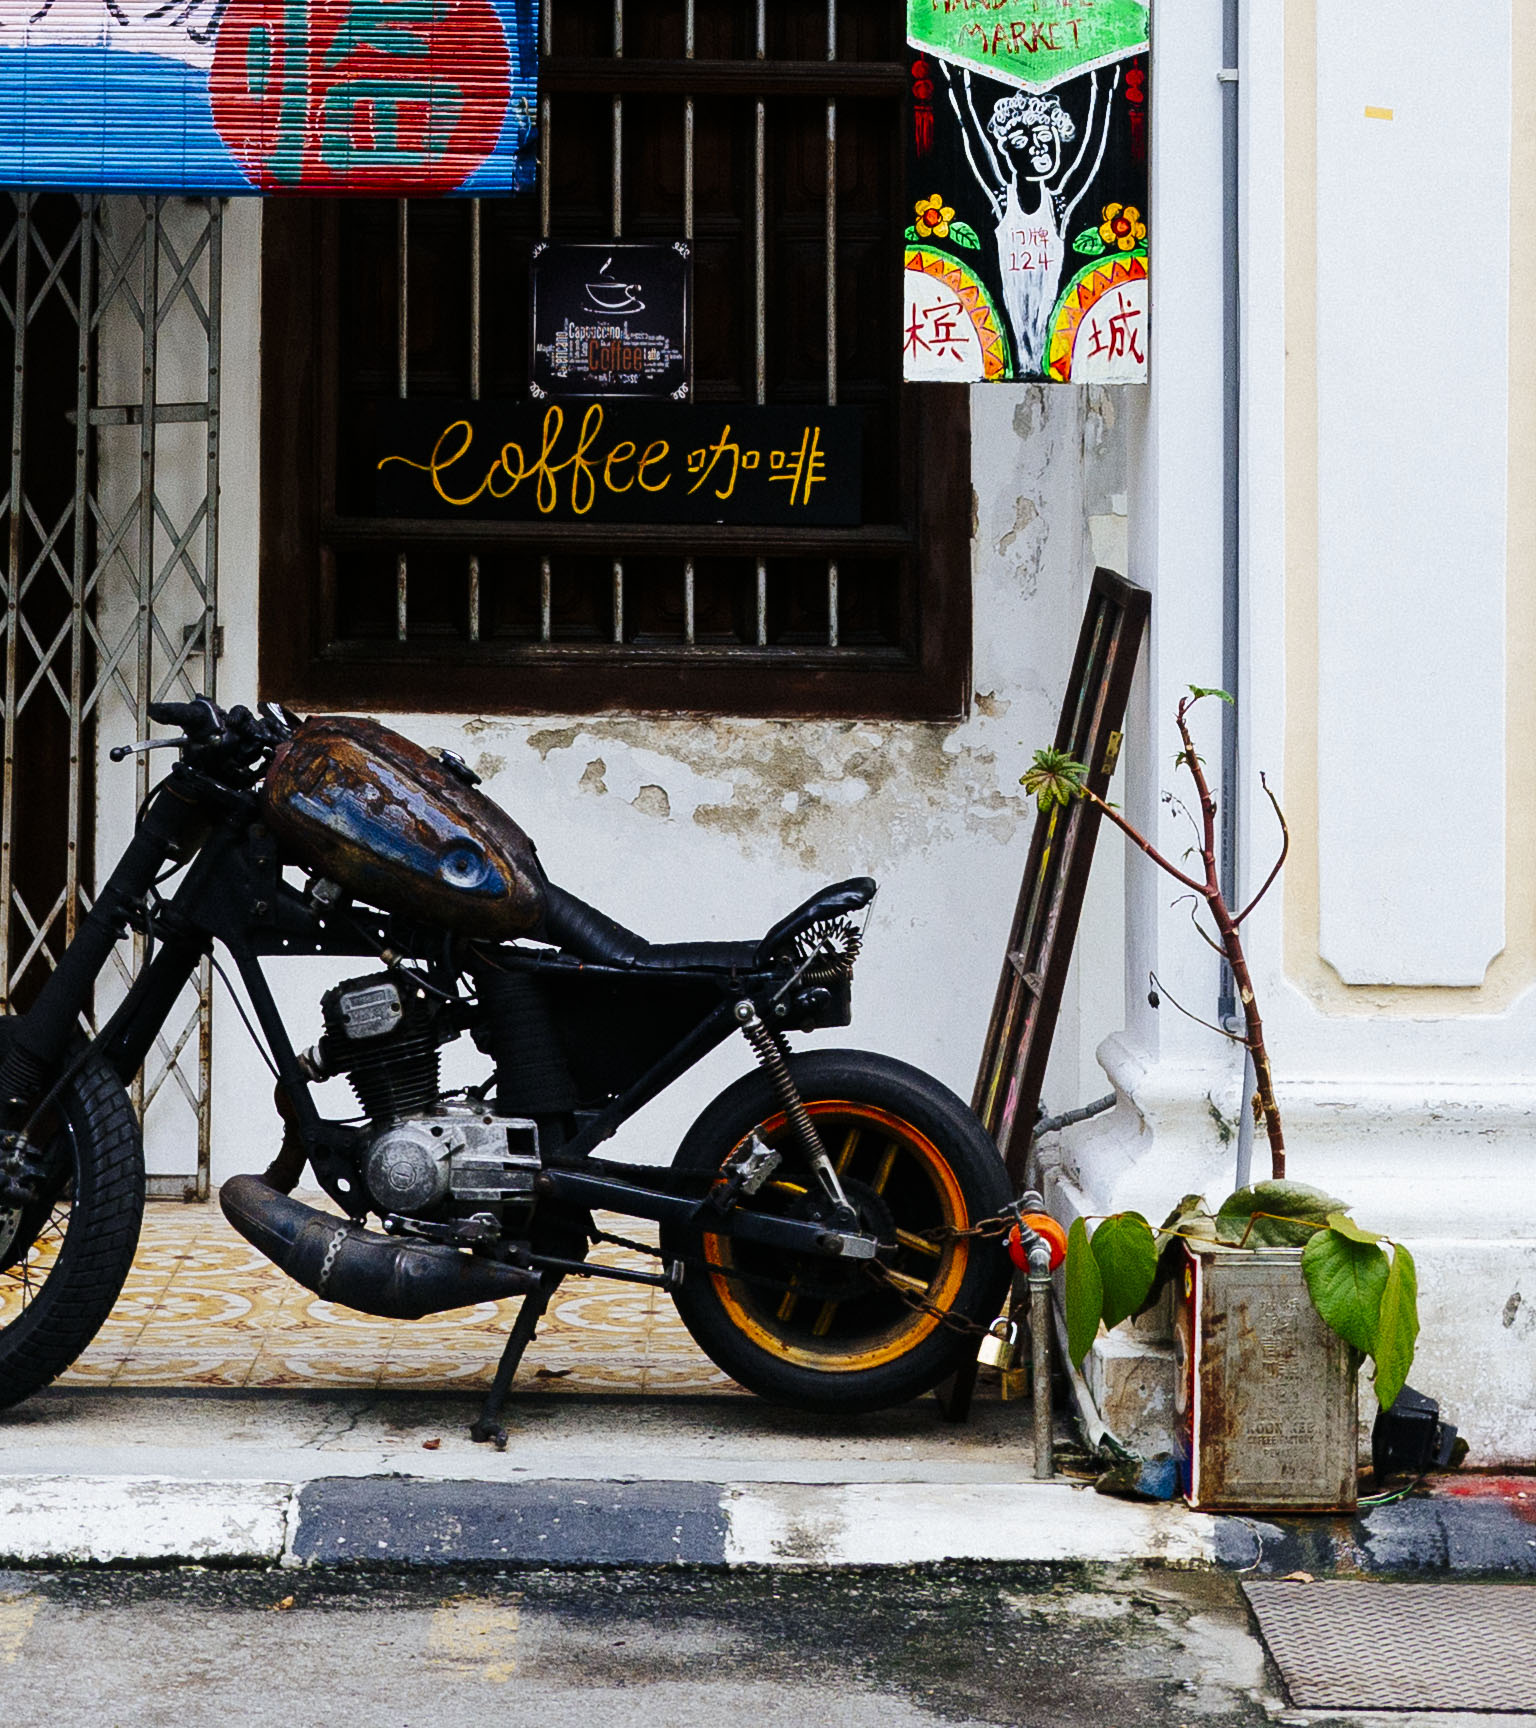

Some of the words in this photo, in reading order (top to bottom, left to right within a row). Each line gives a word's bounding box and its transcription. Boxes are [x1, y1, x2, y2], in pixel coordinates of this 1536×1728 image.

[959, 18, 1082, 54] MARKET
[1010, 225, 1050, 248] 门牌
[1009, 251, 1054, 272] 124
[569, 322, 621, 340] Cappuccino
[1088, 292, 1145, 365] 城
[589, 340, 642, 371] Coffee
[378, 404, 672, 513] Coffee
[687, 425, 826, 505] 咖啡
